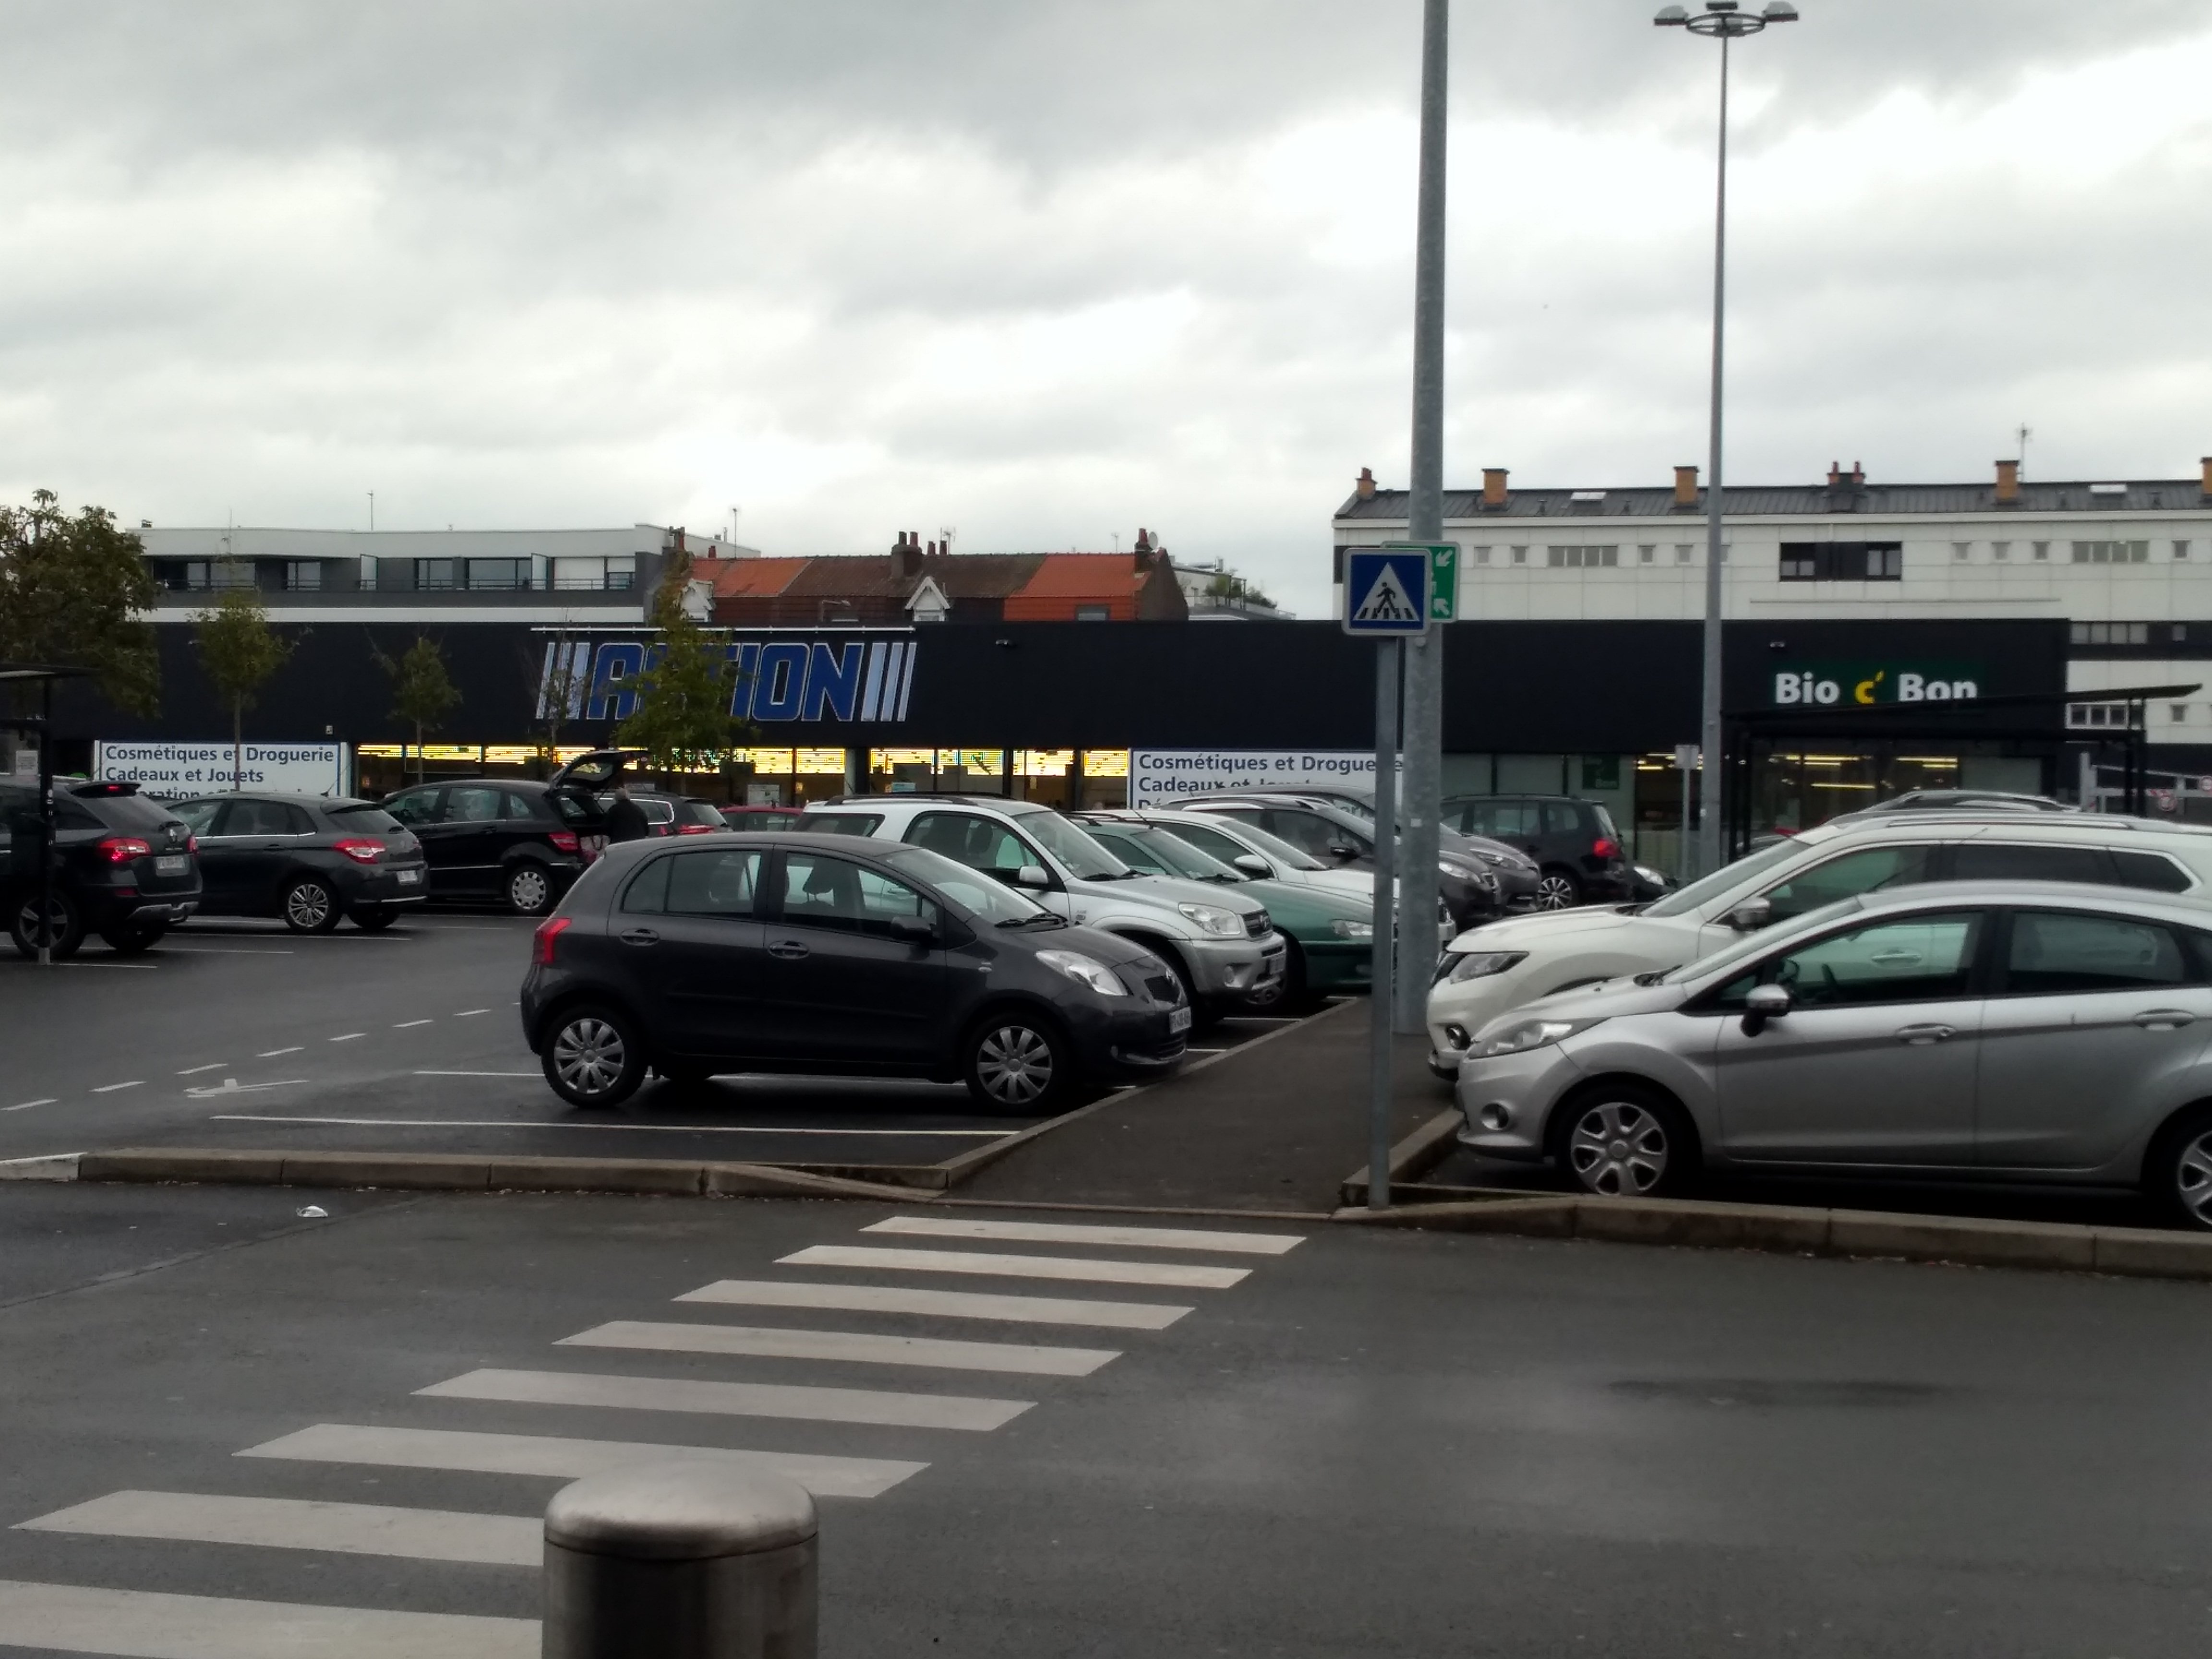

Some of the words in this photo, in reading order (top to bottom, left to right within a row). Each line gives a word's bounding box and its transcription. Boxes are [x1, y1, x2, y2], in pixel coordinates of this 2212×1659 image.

[587, 642, 865, 721] AION
[1775, 671, 1840, 704] Bio
[1898, 673, 1978, 702] Bon
[106, 745, 217, 764] Cosmétiques
[247, 746, 334, 765] Droguerie
[1139, 753, 1268, 774] Cosmétiques
[1275, 756, 1295, 770] et
[106, 766, 180, 781] Cadeaux
[185, 769, 202, 781] et
[207, 768, 264, 782] Jouets
[1138, 776, 1226, 792] Cadeaux
